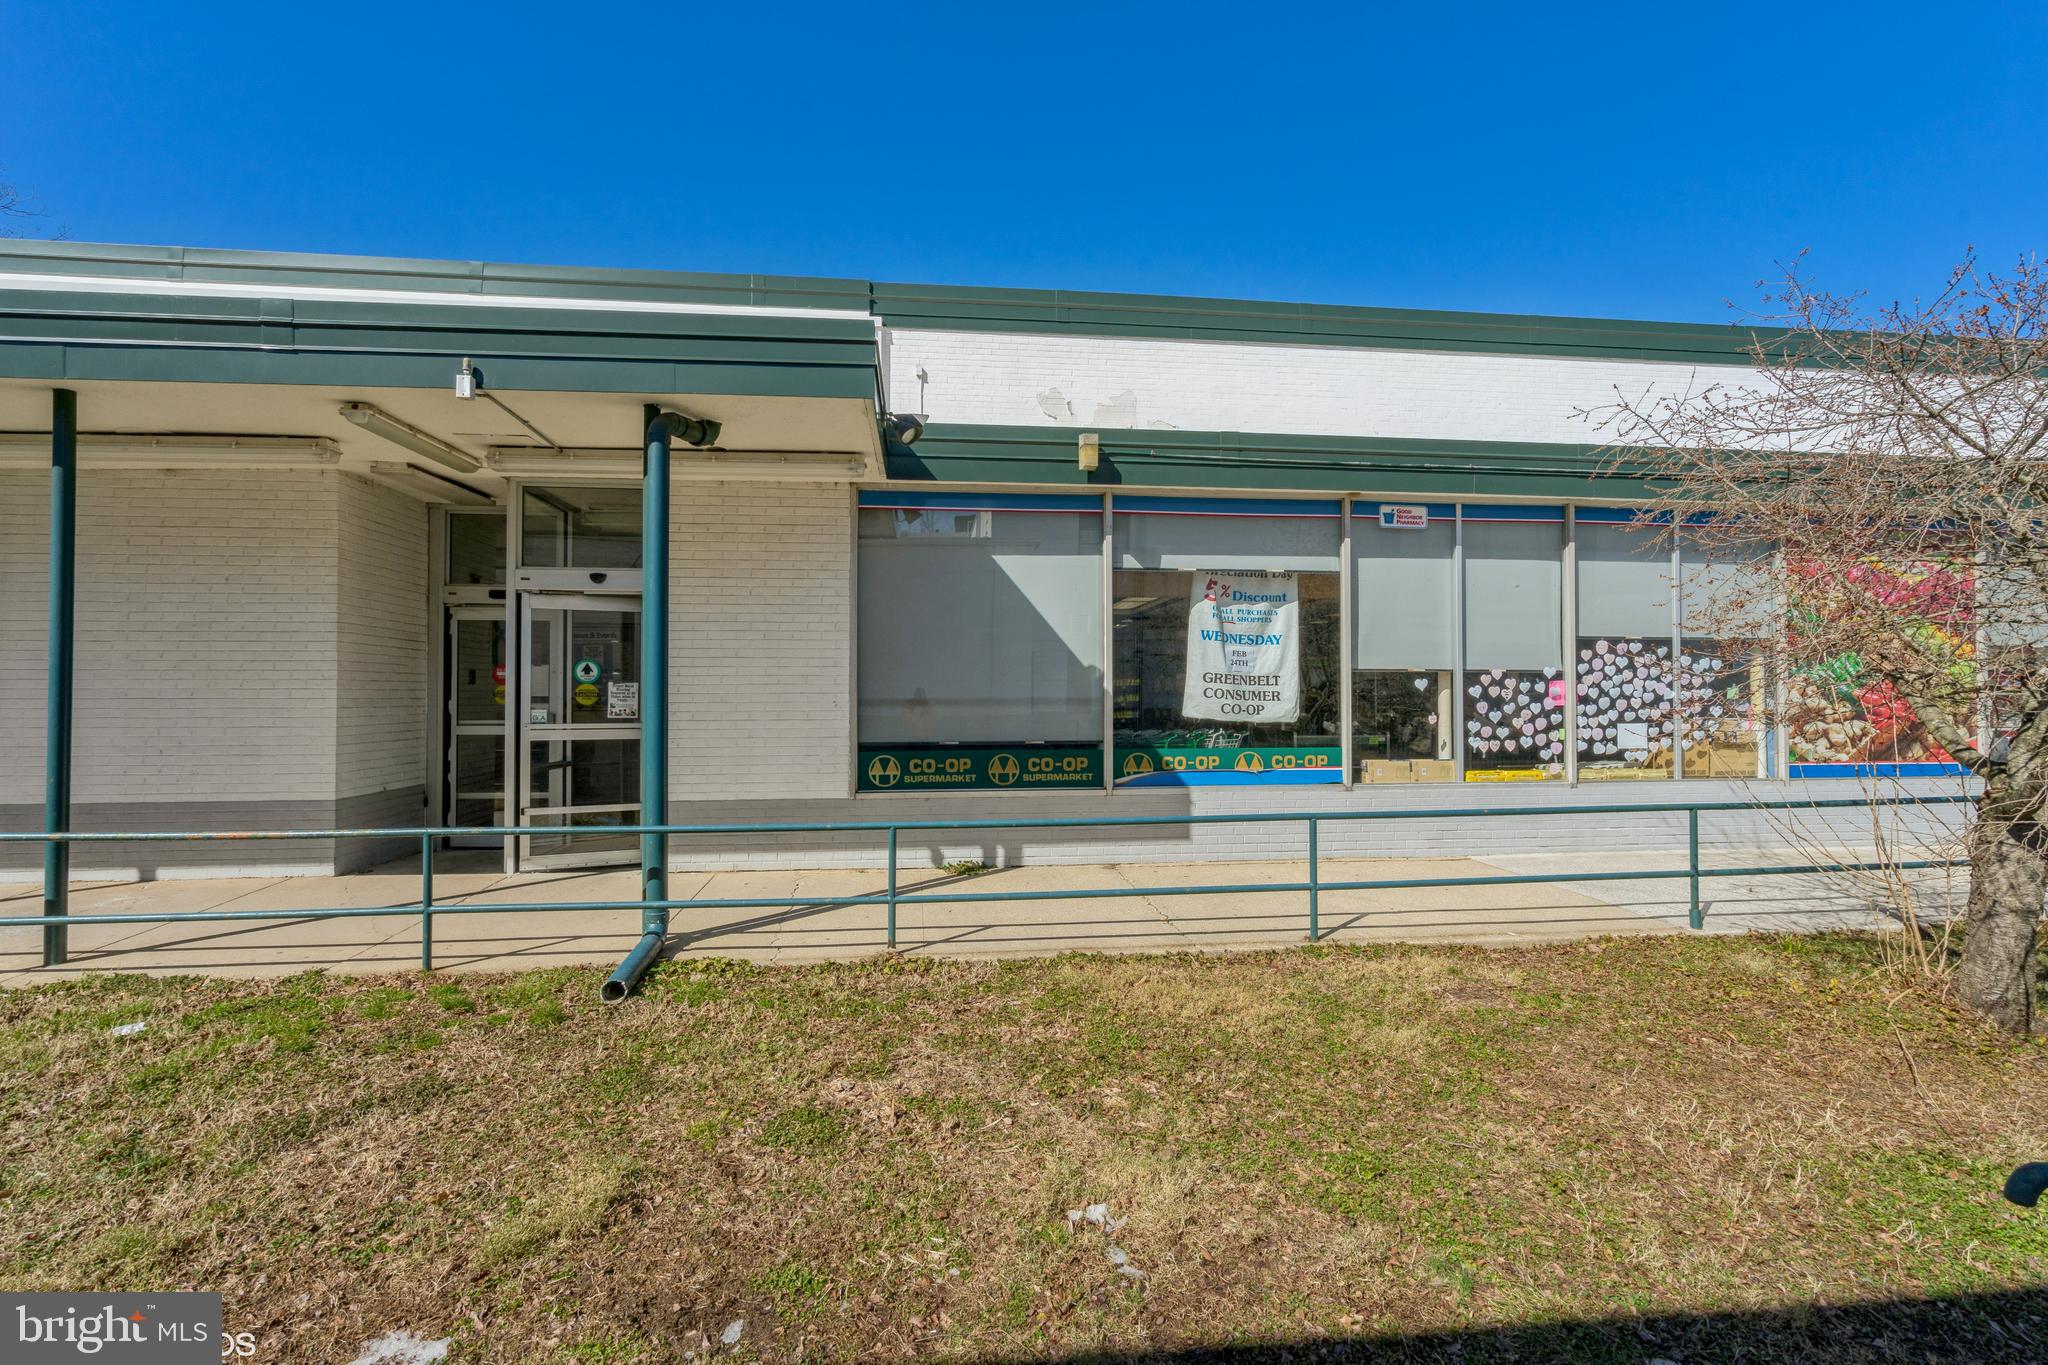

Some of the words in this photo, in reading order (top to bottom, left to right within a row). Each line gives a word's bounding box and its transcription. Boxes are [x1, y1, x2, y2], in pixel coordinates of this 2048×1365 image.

[1232, 590, 1287, 603] Discount
[1201, 629, 1283, 646] WEDNESDAY
[1232, 650, 1247, 658] FEB
[1202, 672, 1281, 686] GREENBELT
[1203, 688, 1281, 702] CONSUMER
[1221, 703, 1265, 716] CO-OP
[909, 758, 972, 773] CO-OP
[1027, 757, 1089, 772] CO-OP
[1161, 756, 1220, 770] CO-OP
[1271, 755, 1328, 768] CO-OP
[904, 773, 977, 783] SUPERMARKET
[1022, 772, 1094, 782] SUPERMARKET
